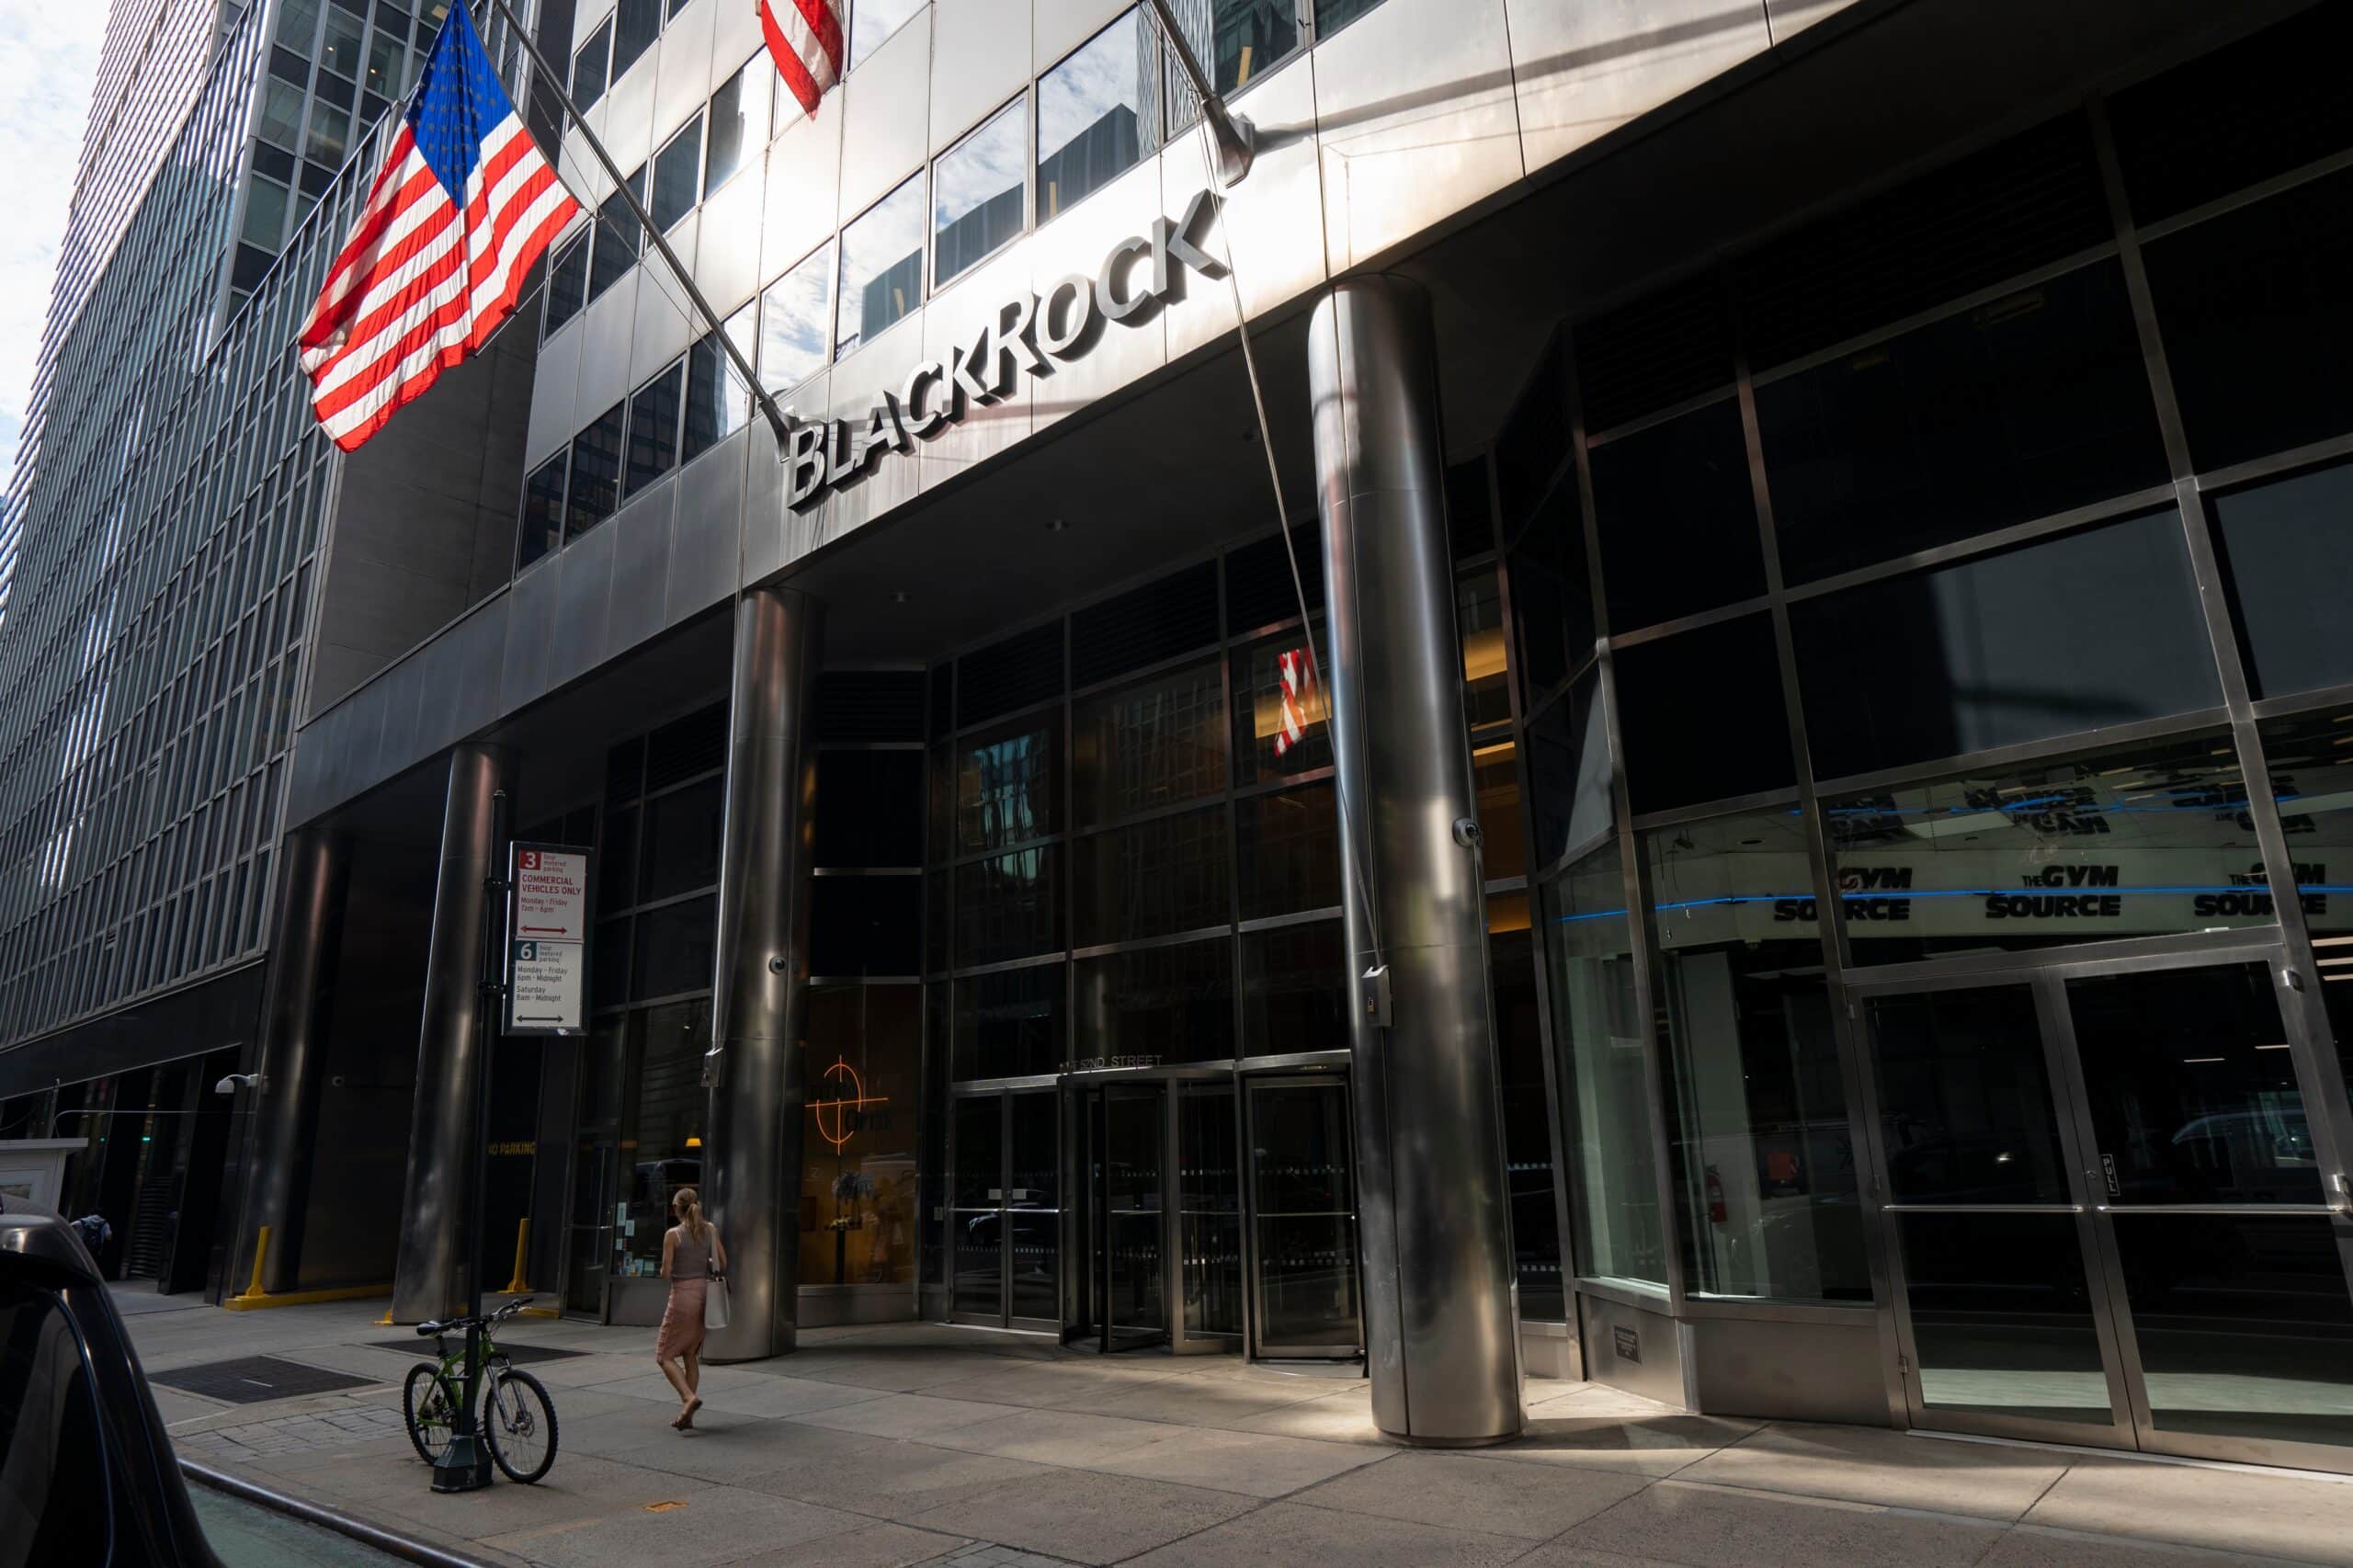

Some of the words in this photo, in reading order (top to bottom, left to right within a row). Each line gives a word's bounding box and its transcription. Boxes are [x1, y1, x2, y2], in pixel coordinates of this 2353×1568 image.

[788, 187, 1231, 515] BLACKROCK
[524, 852, 536, 869] 3
[522, 875, 574, 886] COMMERCIAL
[2251, 863, 2325, 884] GM
[522, 884, 560, 894] VEHICLES
[562, 886, 581, 895] ONLY
[521, 897, 544, 905] Monday
[1985, 895, 2120, 918] SOURCE
[1774, 899, 1910, 920] SORCE
[520, 942, 532, 960] 6
[517, 966, 543, 974] Monday
[549, 967, 568, 975] Friday
[537, 974, 562, 983] Midnight
[517, 985, 546, 994] Saturday
[536, 994, 561, 1002] Midnight
[1110, 1054, 1163, 1067] STREET
[499, 1140, 537, 1155] PARKING
[2102, 1157, 2117, 1192] PULL
